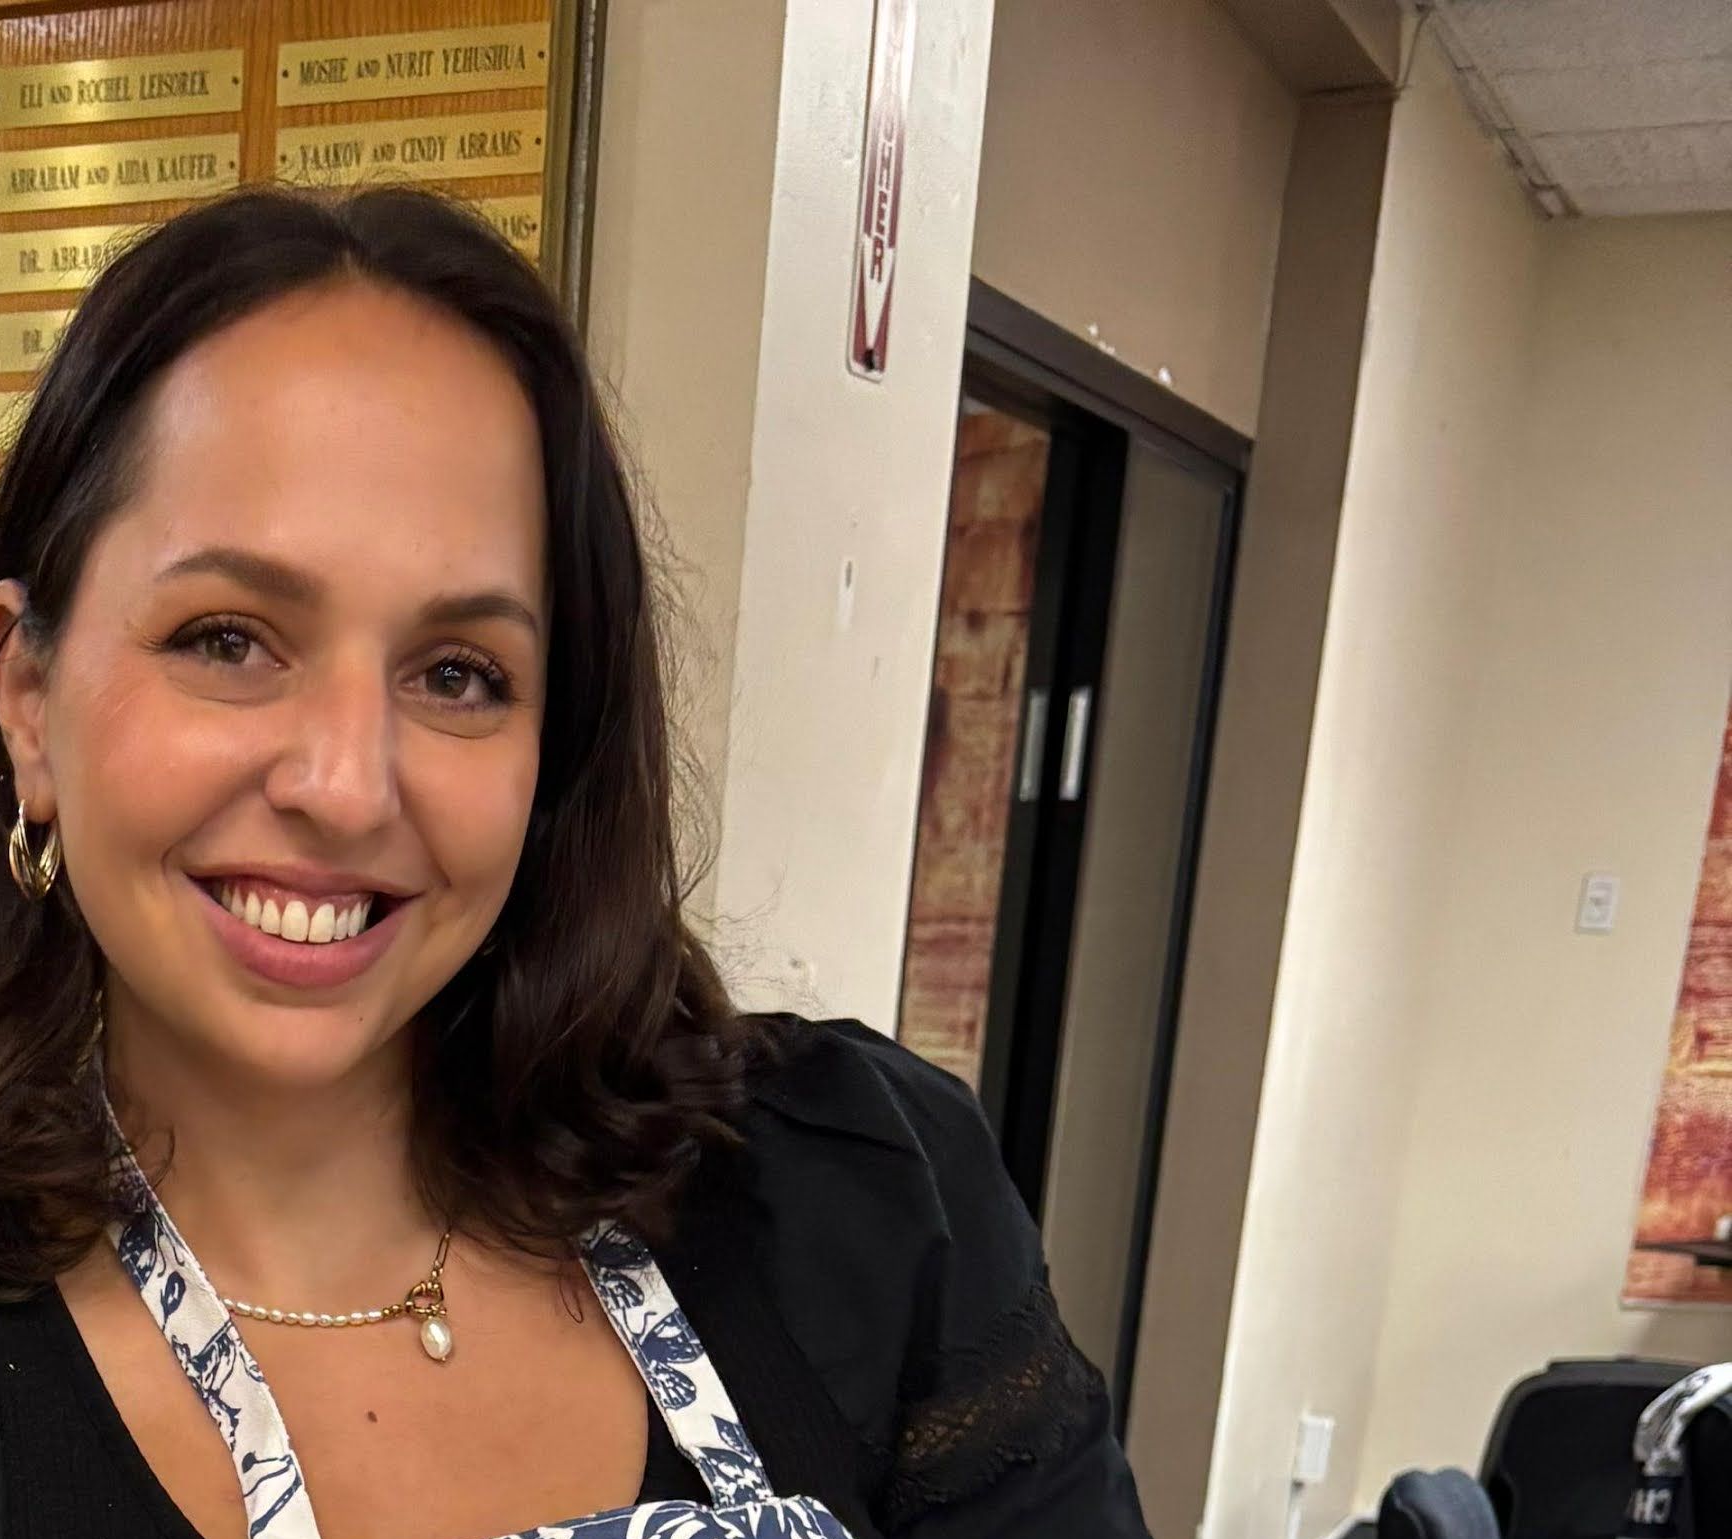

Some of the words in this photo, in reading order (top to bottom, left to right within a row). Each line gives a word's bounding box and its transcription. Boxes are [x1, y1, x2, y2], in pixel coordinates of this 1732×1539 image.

[299, 57, 350, 86] MOSHE
[356, 59, 380, 78] AND
[50, 86, 72, 104] AND
[373, 143, 397, 163] AND
[401, 136, 449, 164] CINDY
[456, 130, 523, 160] ABRAMS
[10, 164, 81, 194] ABRAHAM
[86, 167, 110, 186] AND
